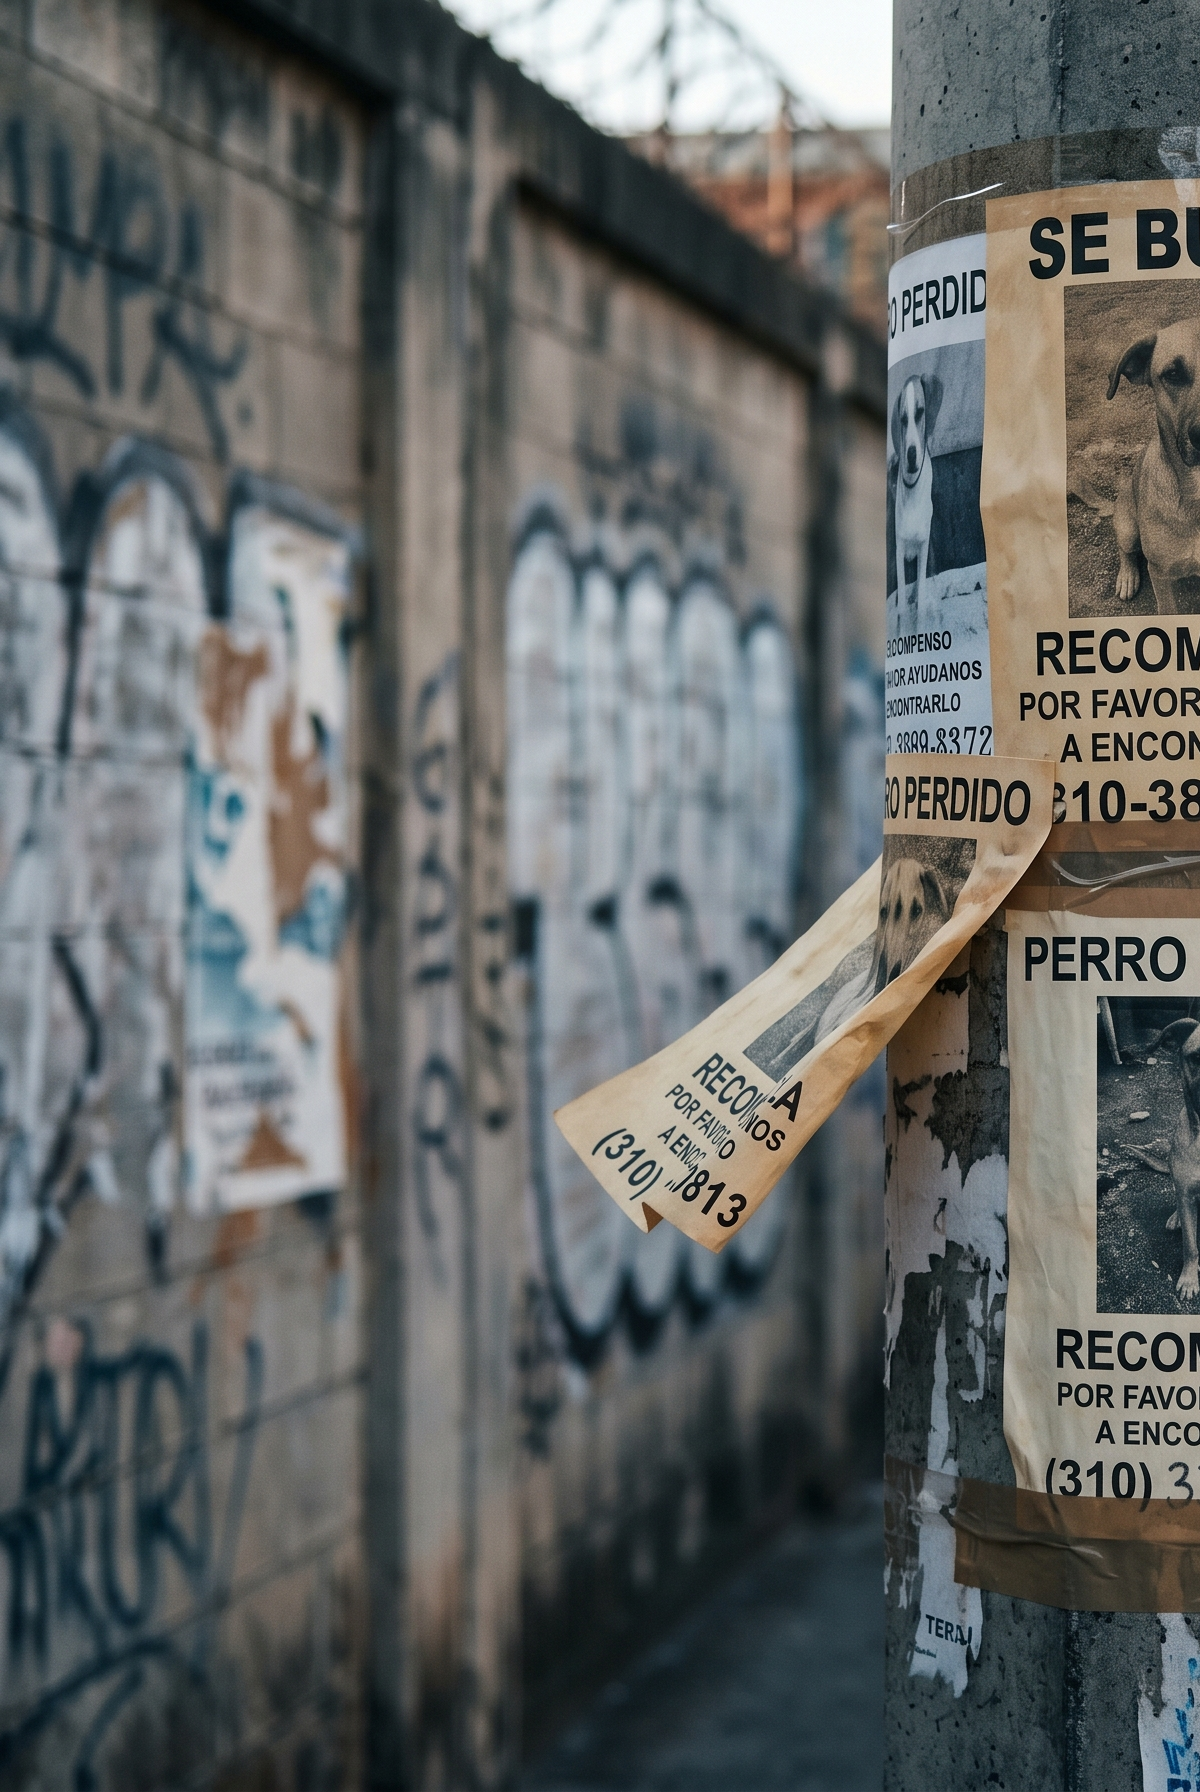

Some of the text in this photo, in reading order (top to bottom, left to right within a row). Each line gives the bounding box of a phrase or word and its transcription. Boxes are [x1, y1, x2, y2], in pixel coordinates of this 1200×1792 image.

[1029, 212, 1110, 280] SE
[907, 660, 983, 686] AYUDANOS
[1019, 690, 1081, 722] POR
[1060, 733, 1084, 763] A
[904, 776, 1031, 826] PERDIDO
[1024, 936, 1187, 982] PERRO
[665, 1083, 701, 1120] POR
[592, 1128, 664, 1201] (310)
[1057, 1381, 1115, 1409] POR
[1095, 1420, 1116, 1445] A
[1045, 1457, 1153, 1513] (310)
